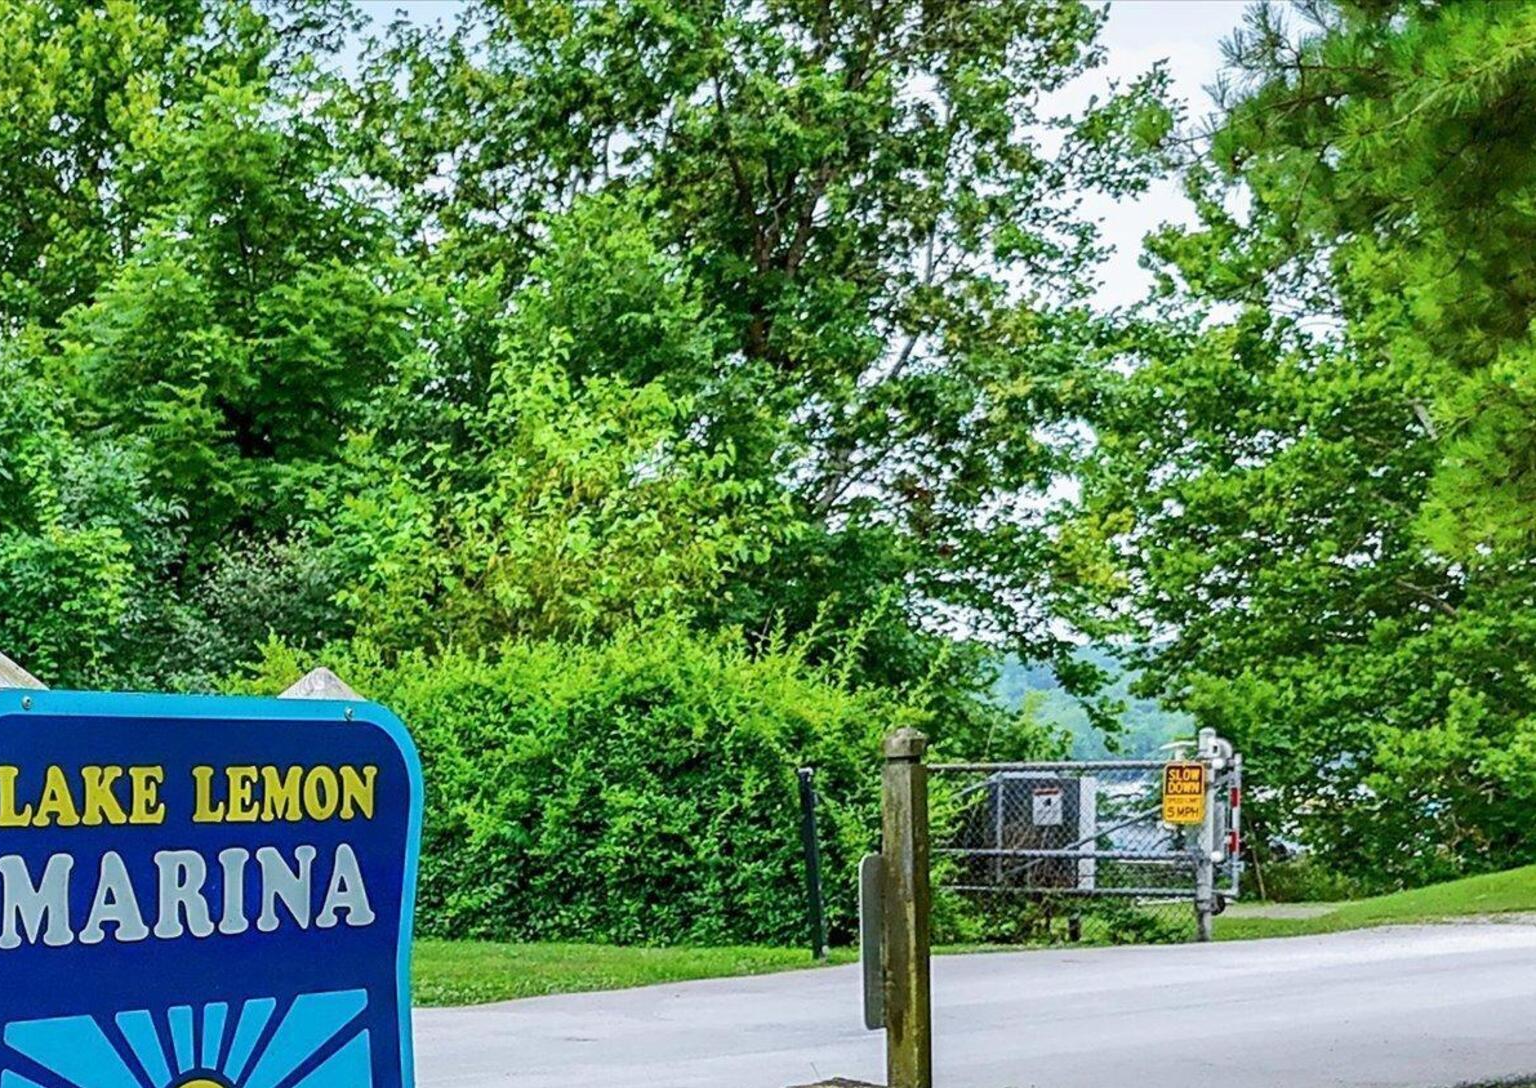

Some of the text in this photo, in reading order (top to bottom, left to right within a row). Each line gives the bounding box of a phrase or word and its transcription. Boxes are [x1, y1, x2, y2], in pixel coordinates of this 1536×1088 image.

[1167, 768, 1200, 781] SLOW
[1167, 781, 1200, 793] DOWN
[192, 765, 378, 823] LEMON
[1177, 806, 1199, 817] MPH
